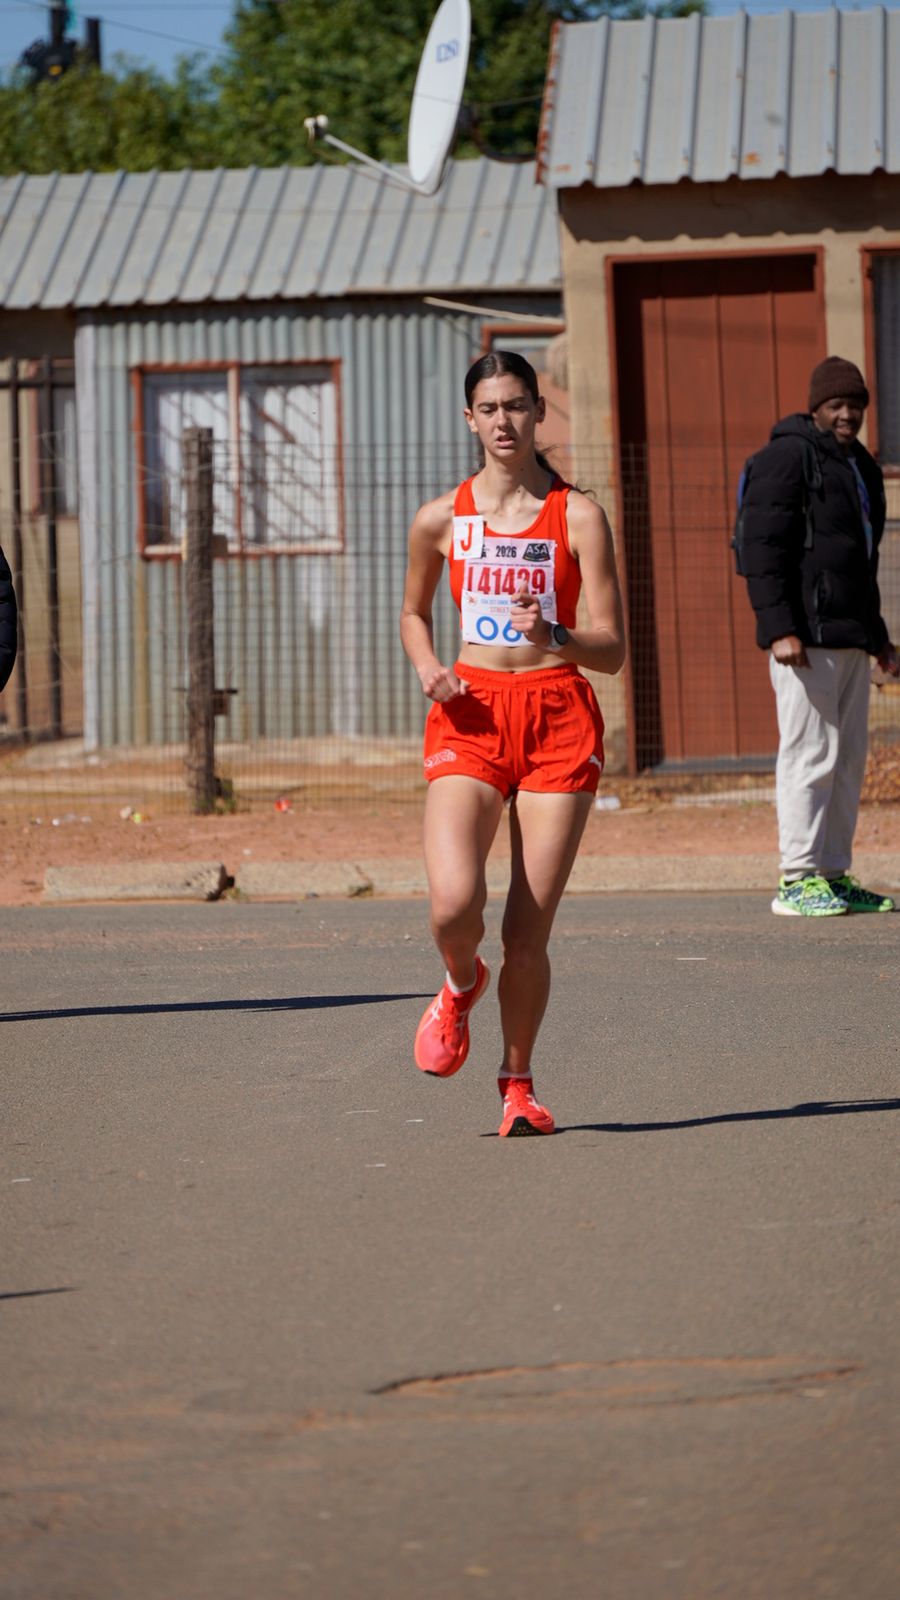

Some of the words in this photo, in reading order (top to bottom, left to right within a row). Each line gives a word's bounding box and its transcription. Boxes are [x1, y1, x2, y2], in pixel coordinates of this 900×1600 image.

[461, 522, 473, 552] J
[495, 545, 517, 558] 2026
[526, 544, 548, 555] ASA
